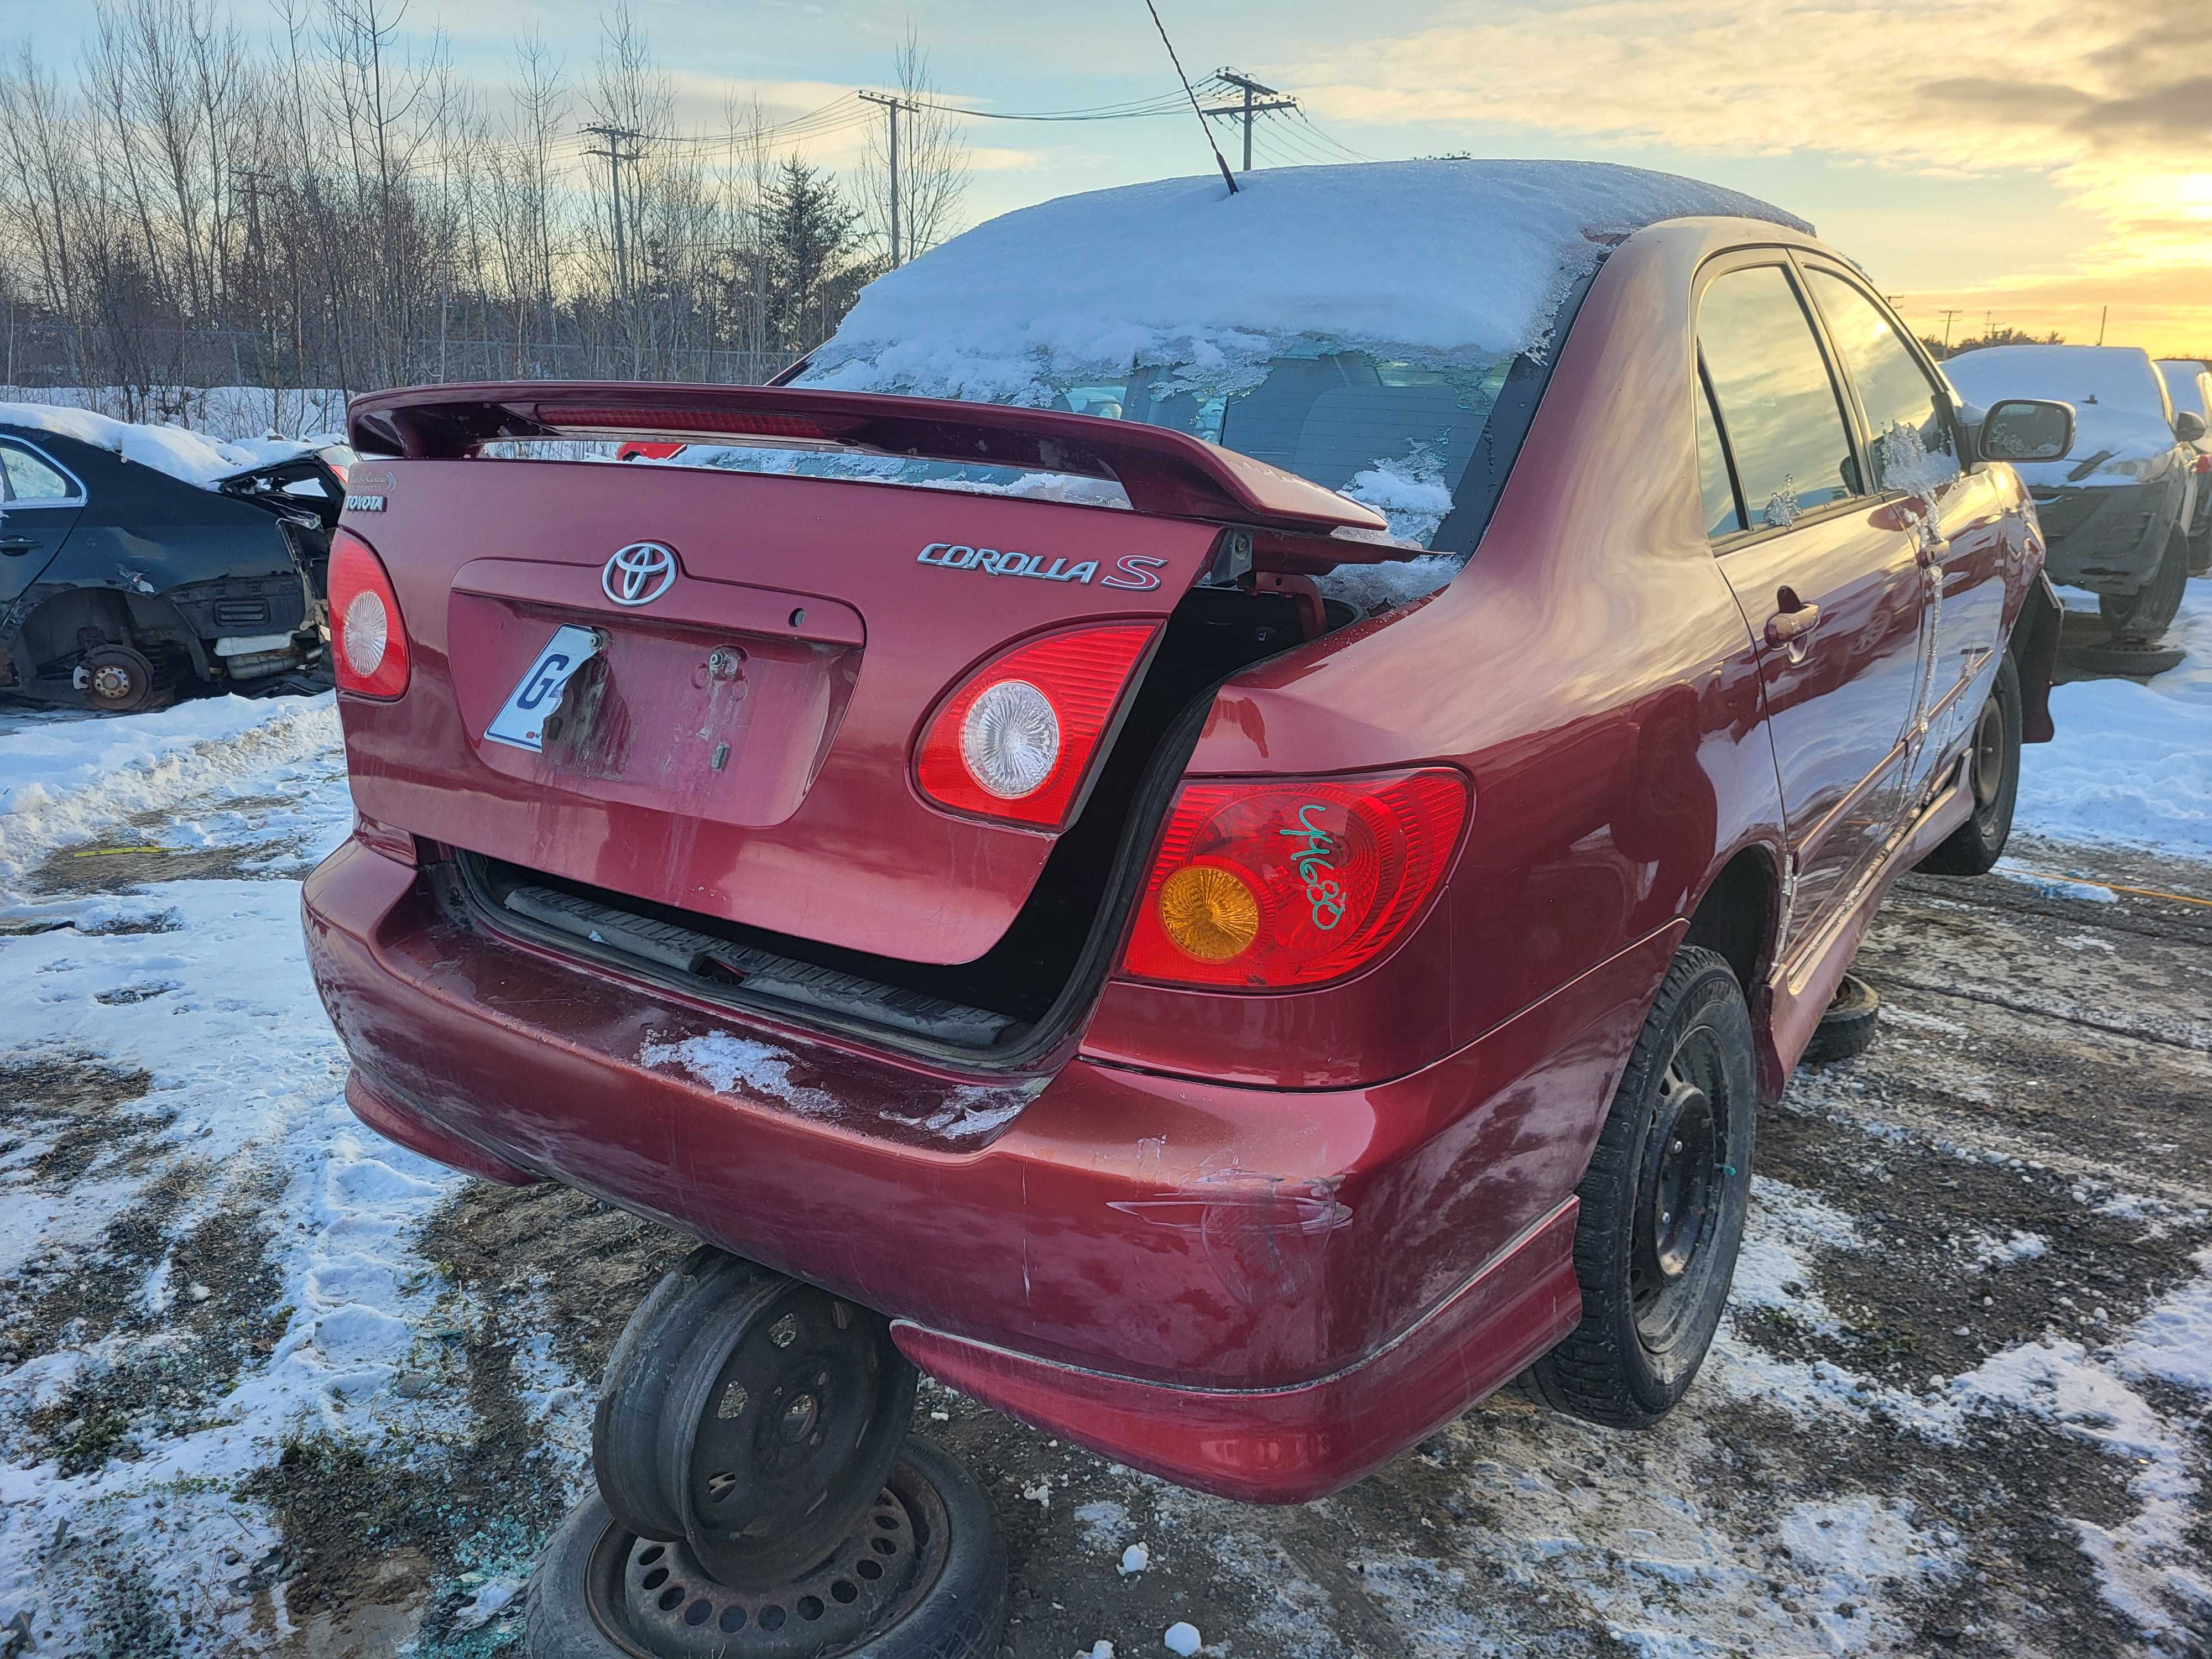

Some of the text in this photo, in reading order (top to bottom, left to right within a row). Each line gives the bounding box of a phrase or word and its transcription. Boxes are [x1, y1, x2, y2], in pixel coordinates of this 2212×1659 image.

[345, 495, 384, 511] TOYOTA
[917, 543, 1168, 592] COROLLA S
[1279, 805, 1346, 930] 44680
